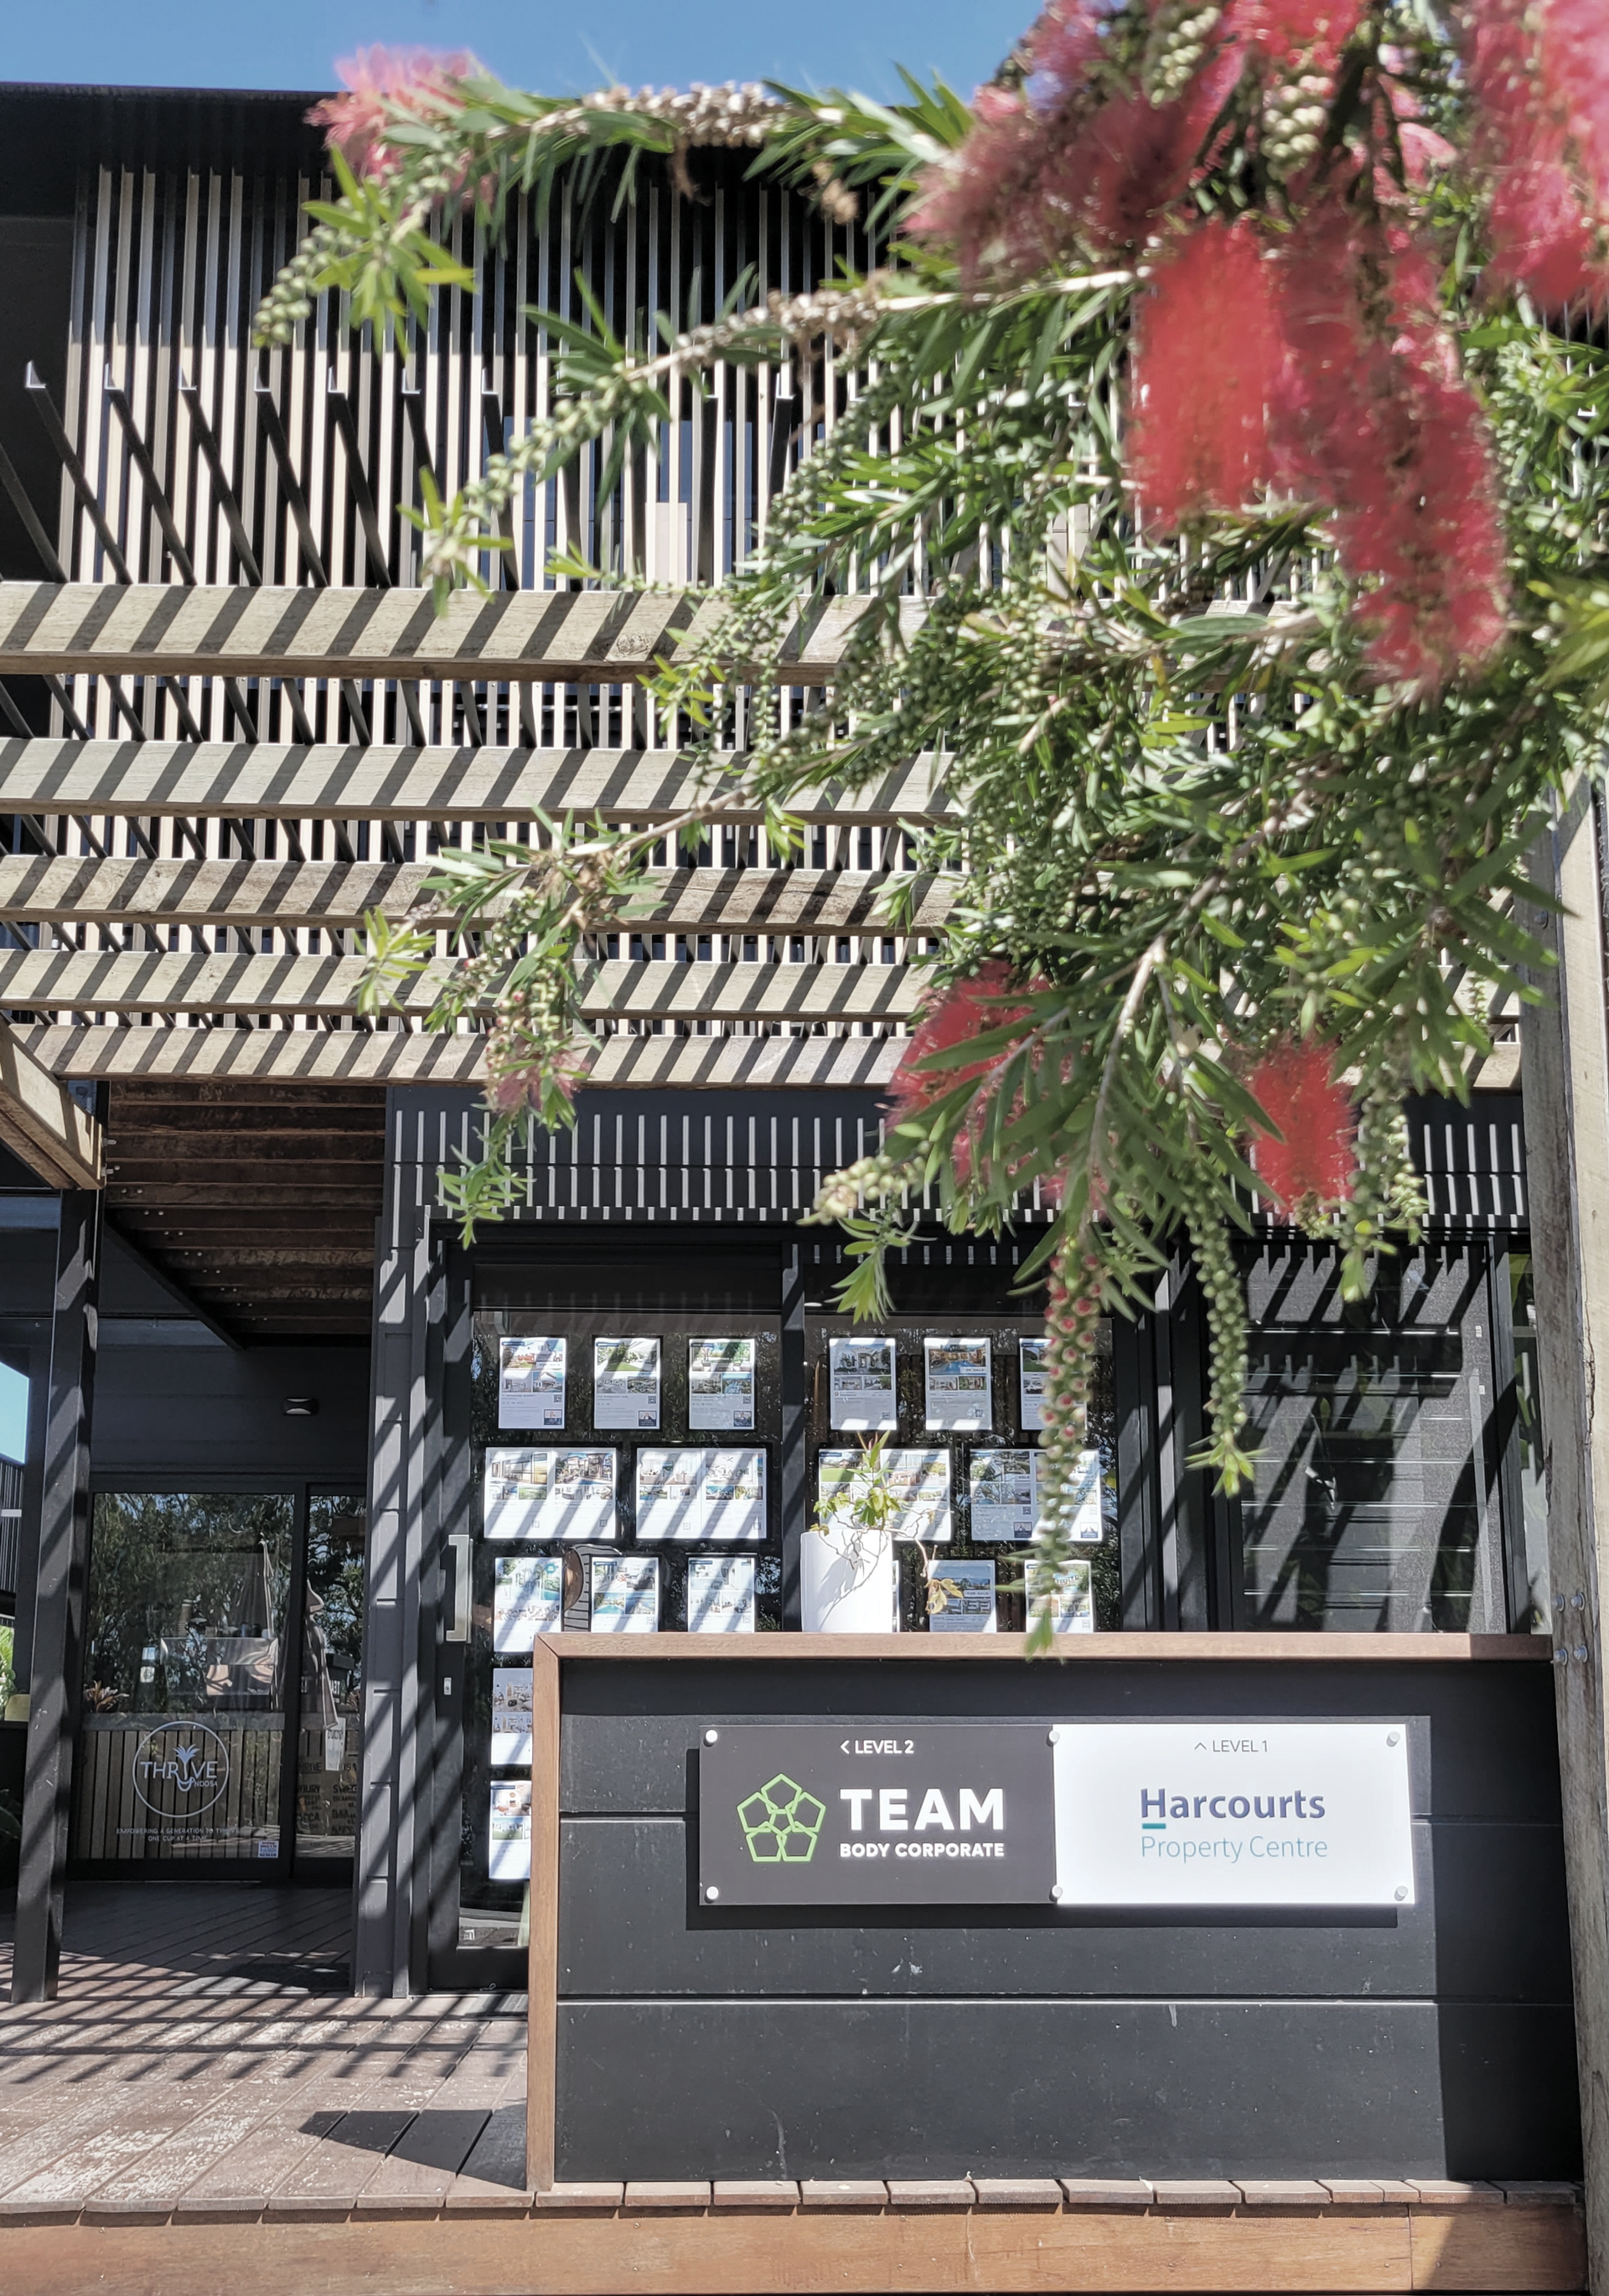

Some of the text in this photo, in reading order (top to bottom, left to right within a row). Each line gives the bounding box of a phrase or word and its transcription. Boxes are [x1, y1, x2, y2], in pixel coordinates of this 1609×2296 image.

[855, 1740, 914, 1754] LEVEL 2
[1212, 1740, 1268, 1753] LEVEL 1
[140, 1758, 218, 1787] THRIVE
[841, 1789, 1004, 1830] TEAM
[1141, 1788, 1326, 1819] Harcourts
[840, 1843, 1005, 1858] BODY CORPORATE
[1141, 1835, 1327, 1864] Property Centre
